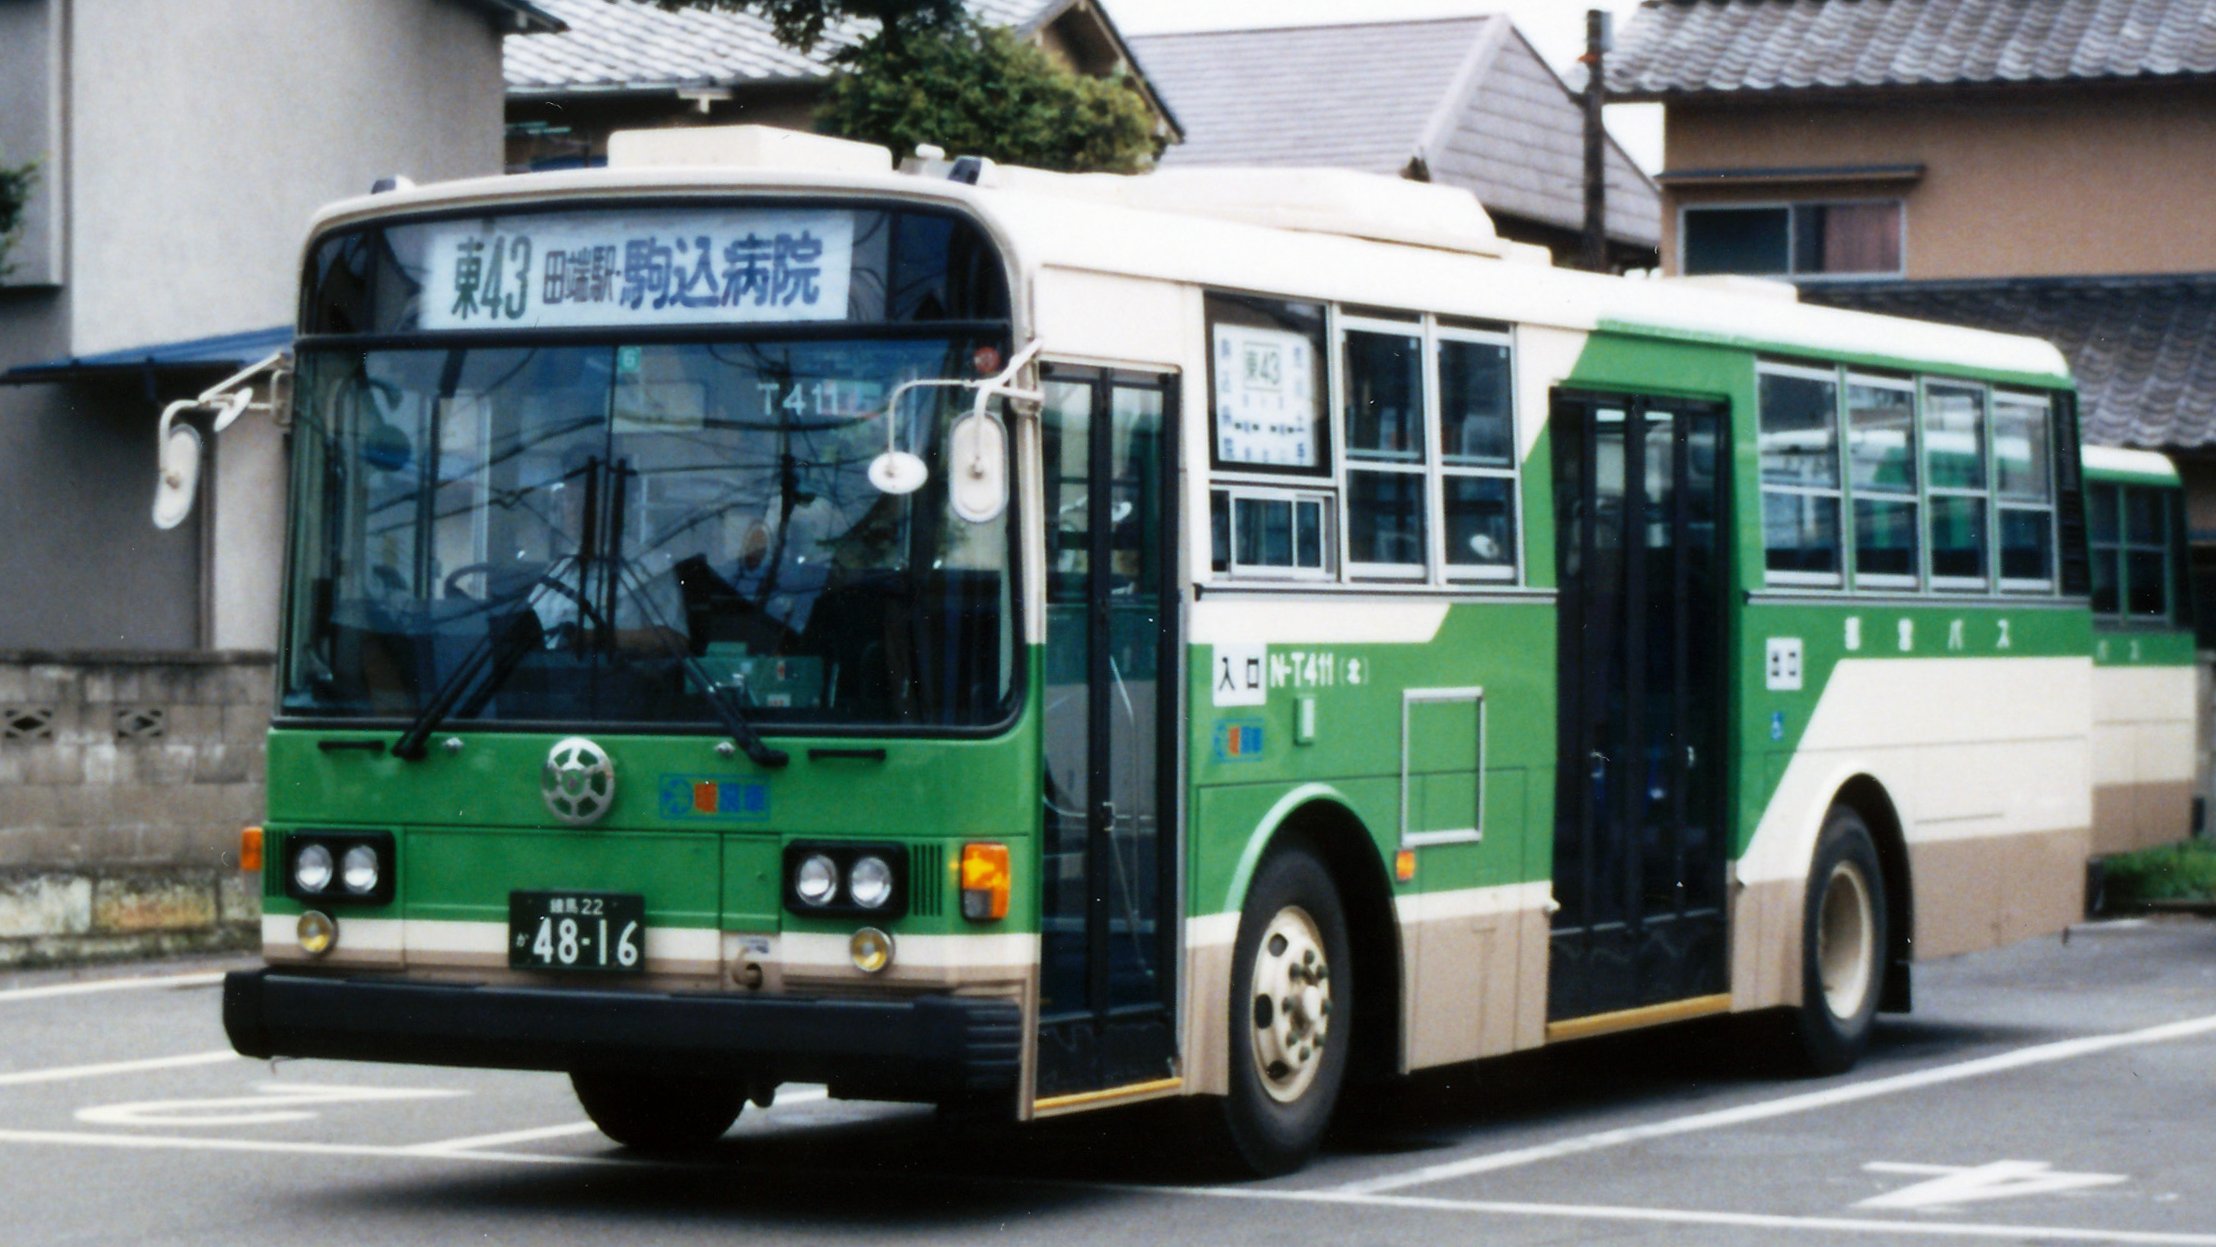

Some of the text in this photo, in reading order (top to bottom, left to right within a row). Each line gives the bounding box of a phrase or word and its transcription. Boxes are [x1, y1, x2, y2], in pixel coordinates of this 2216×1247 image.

[451, 235, 532, 321] 東43
[1218, 656, 1260, 691] 入口
[533, 917, 638, 967] 48-16
